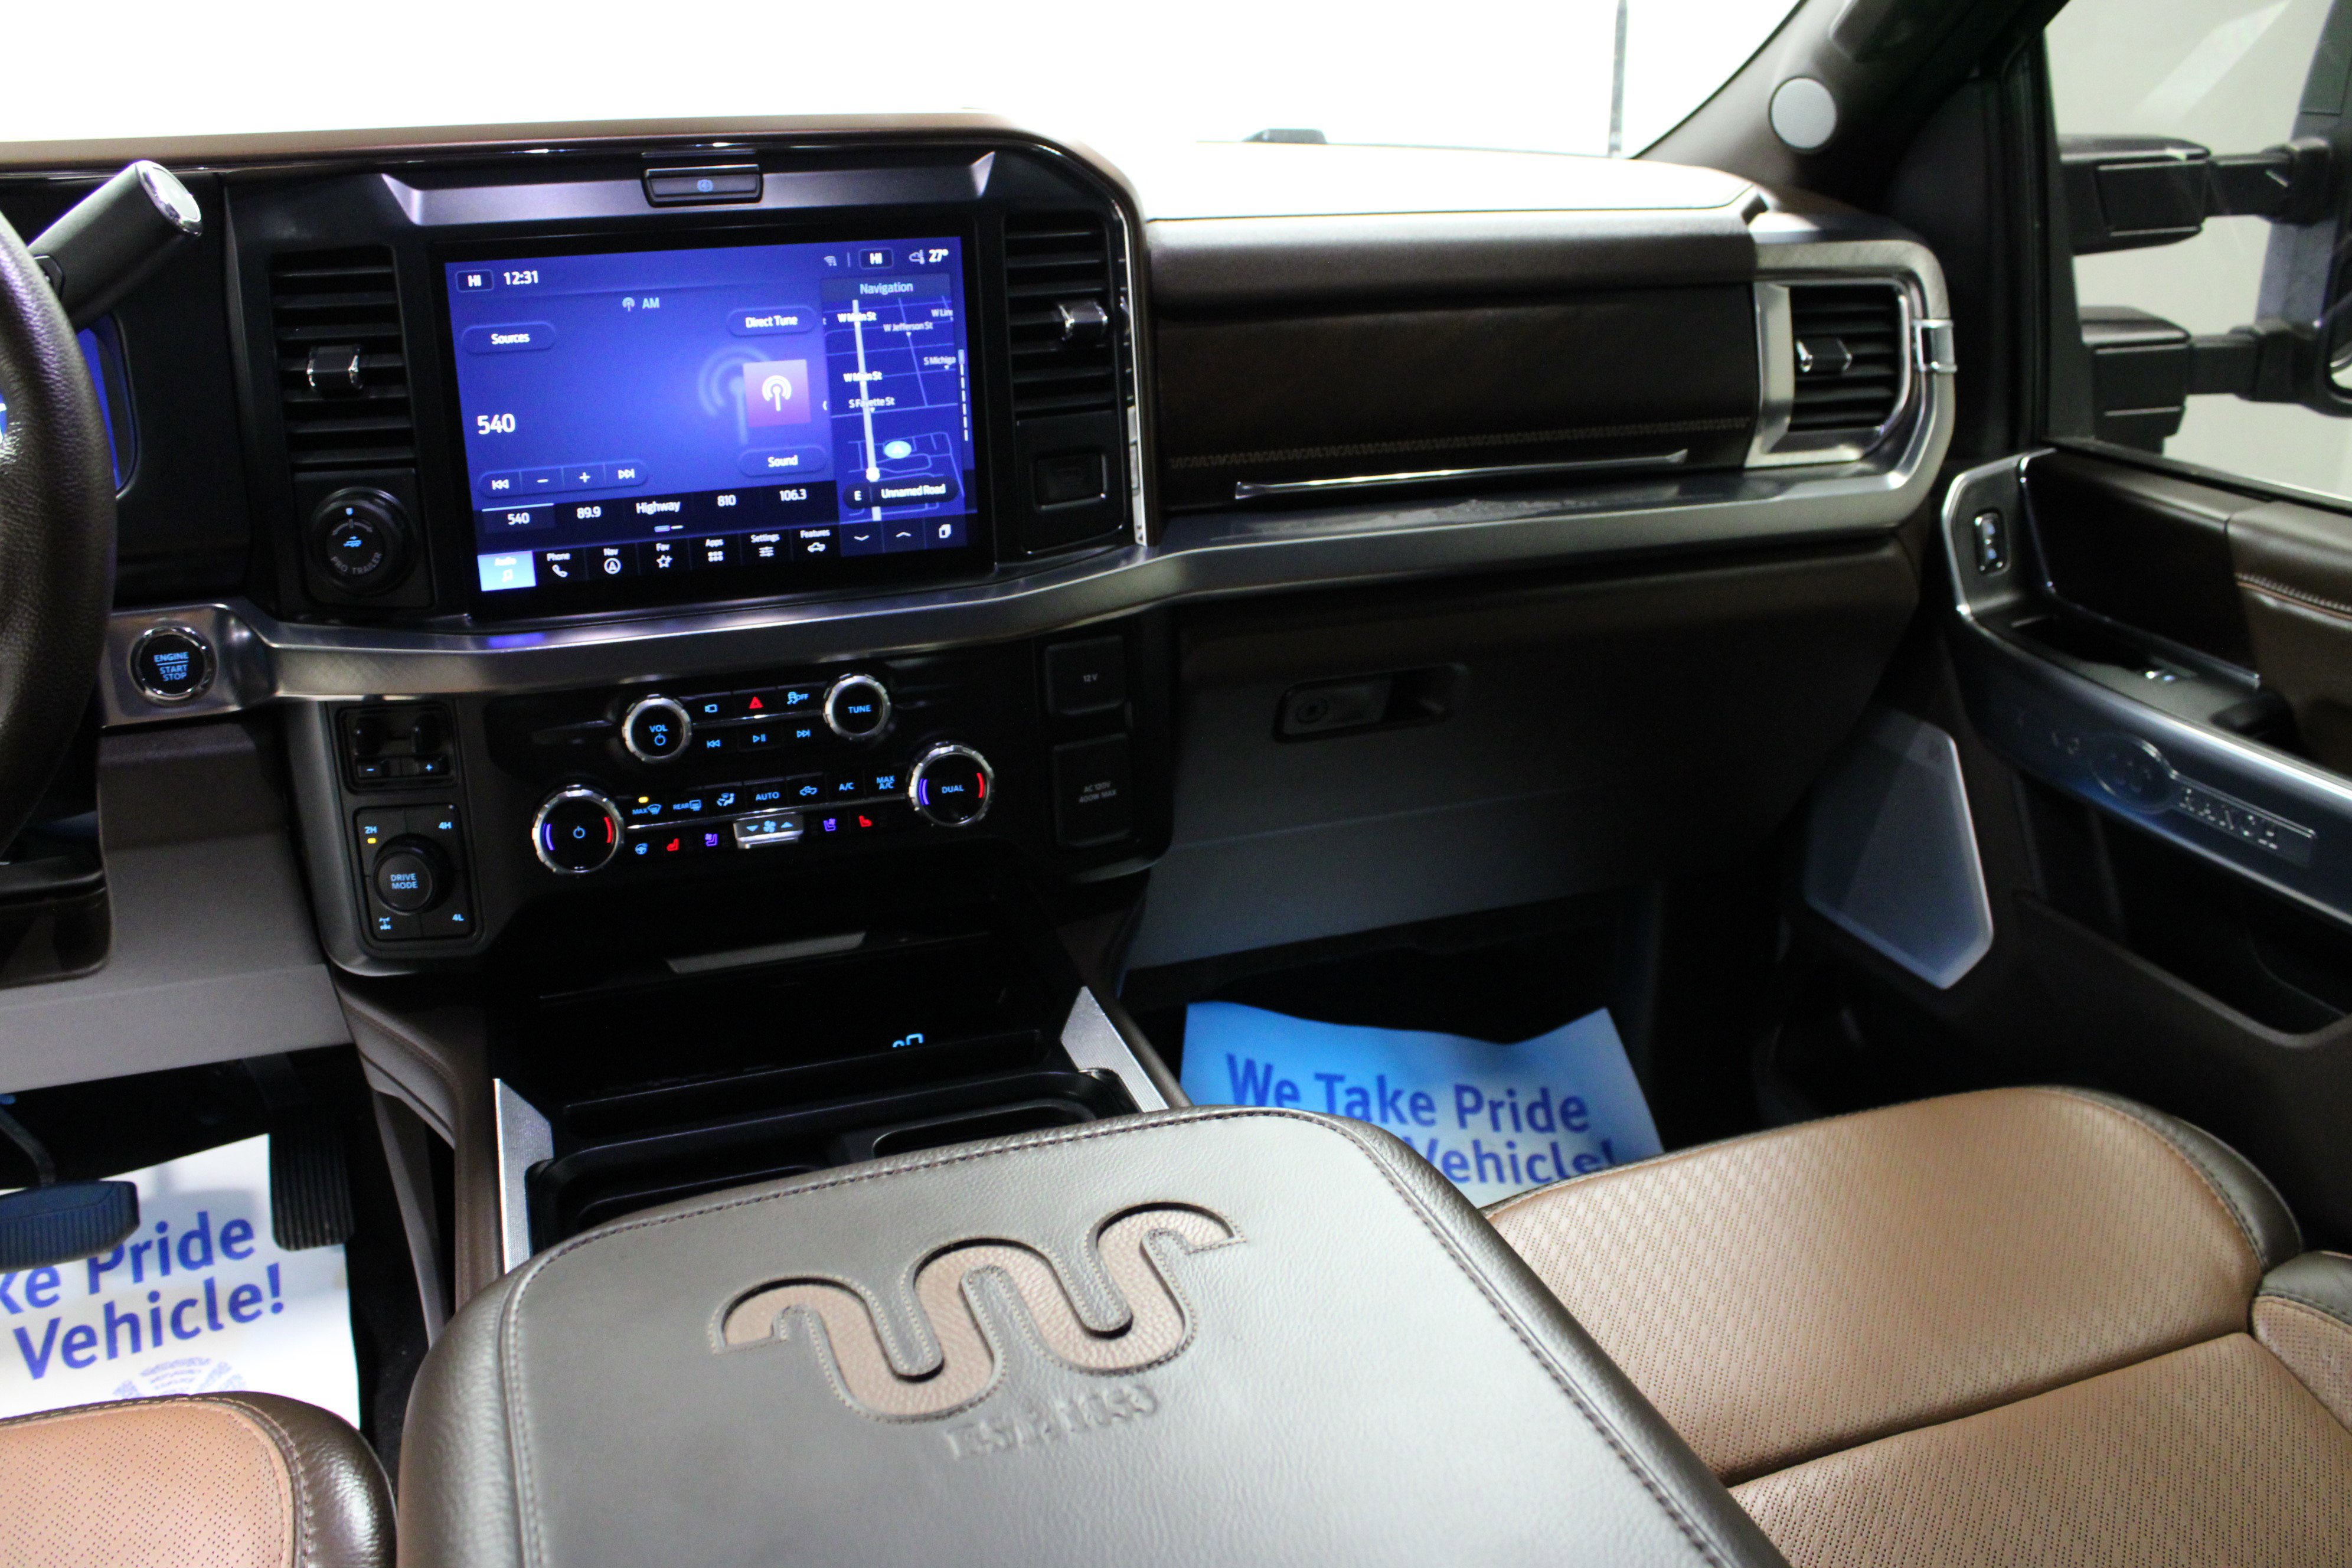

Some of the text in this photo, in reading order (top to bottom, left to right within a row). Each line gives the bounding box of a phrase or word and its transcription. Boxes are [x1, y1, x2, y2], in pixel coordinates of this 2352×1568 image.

[870, 253, 883, 264] HI
[468, 274, 482, 287] HI
[503, 270, 538, 286] 12:31
[860, 282, 913, 295] Navigation
[642, 297, 660, 309] AM
[745, 315, 798, 328] Direct Tune
[837, 313, 847, 322] W
[867, 311, 877, 321] St
[883, 321, 933, 332] W Jefferson St
[491, 333, 530, 345] Sources
[923, 357, 929, 365] S
[843, 373, 852, 382] W
[872, 371, 883, 381] St
[848, 399, 855, 408] S
[885, 397, 895, 406] St
[477, 413, 516, 435] 540
[767, 455, 798, 468] Sound
[854, 484, 946, 501] E Unnamed Road
[507, 488, 807, 525] 540 89.9 Highway 810 106.3
[750, 534, 780, 543] Settings
[800, 529, 831, 538] Features
[656, 543, 671, 551] Fav
[705, 538, 724, 548] Apps
[547, 553, 571, 561] Phone
[603, 548, 619, 556] Nav
[153, 652, 190, 663] ENGINE
[159, 664, 188, 675] START
[163, 672, 187, 682] STOP
[796, 692, 809, 700] OFF
[848, 705, 871, 714] TUNE
[649, 724, 668, 733] VOL
[876, 776, 895, 784] MAX
[838, 782, 855, 792] A/C
[879, 782, 894, 790] A/C
[942, 785, 965, 794] DUAL
[755, 791, 780, 801] AUTO
[673, 802, 689, 811] REAR
[364, 826, 378, 834] 2H
[439, 821, 453, 830] 4H
[390, 873, 417, 881] DRIVE
[391, 881, 419, 890] MODE
[452, 913, 465, 922] 4L
[1225, 1053, 1592, 1133] We Take Pride
[87, 1210, 255, 1295] Pride
[13, 1262, 285, 1380] Vehicle!
